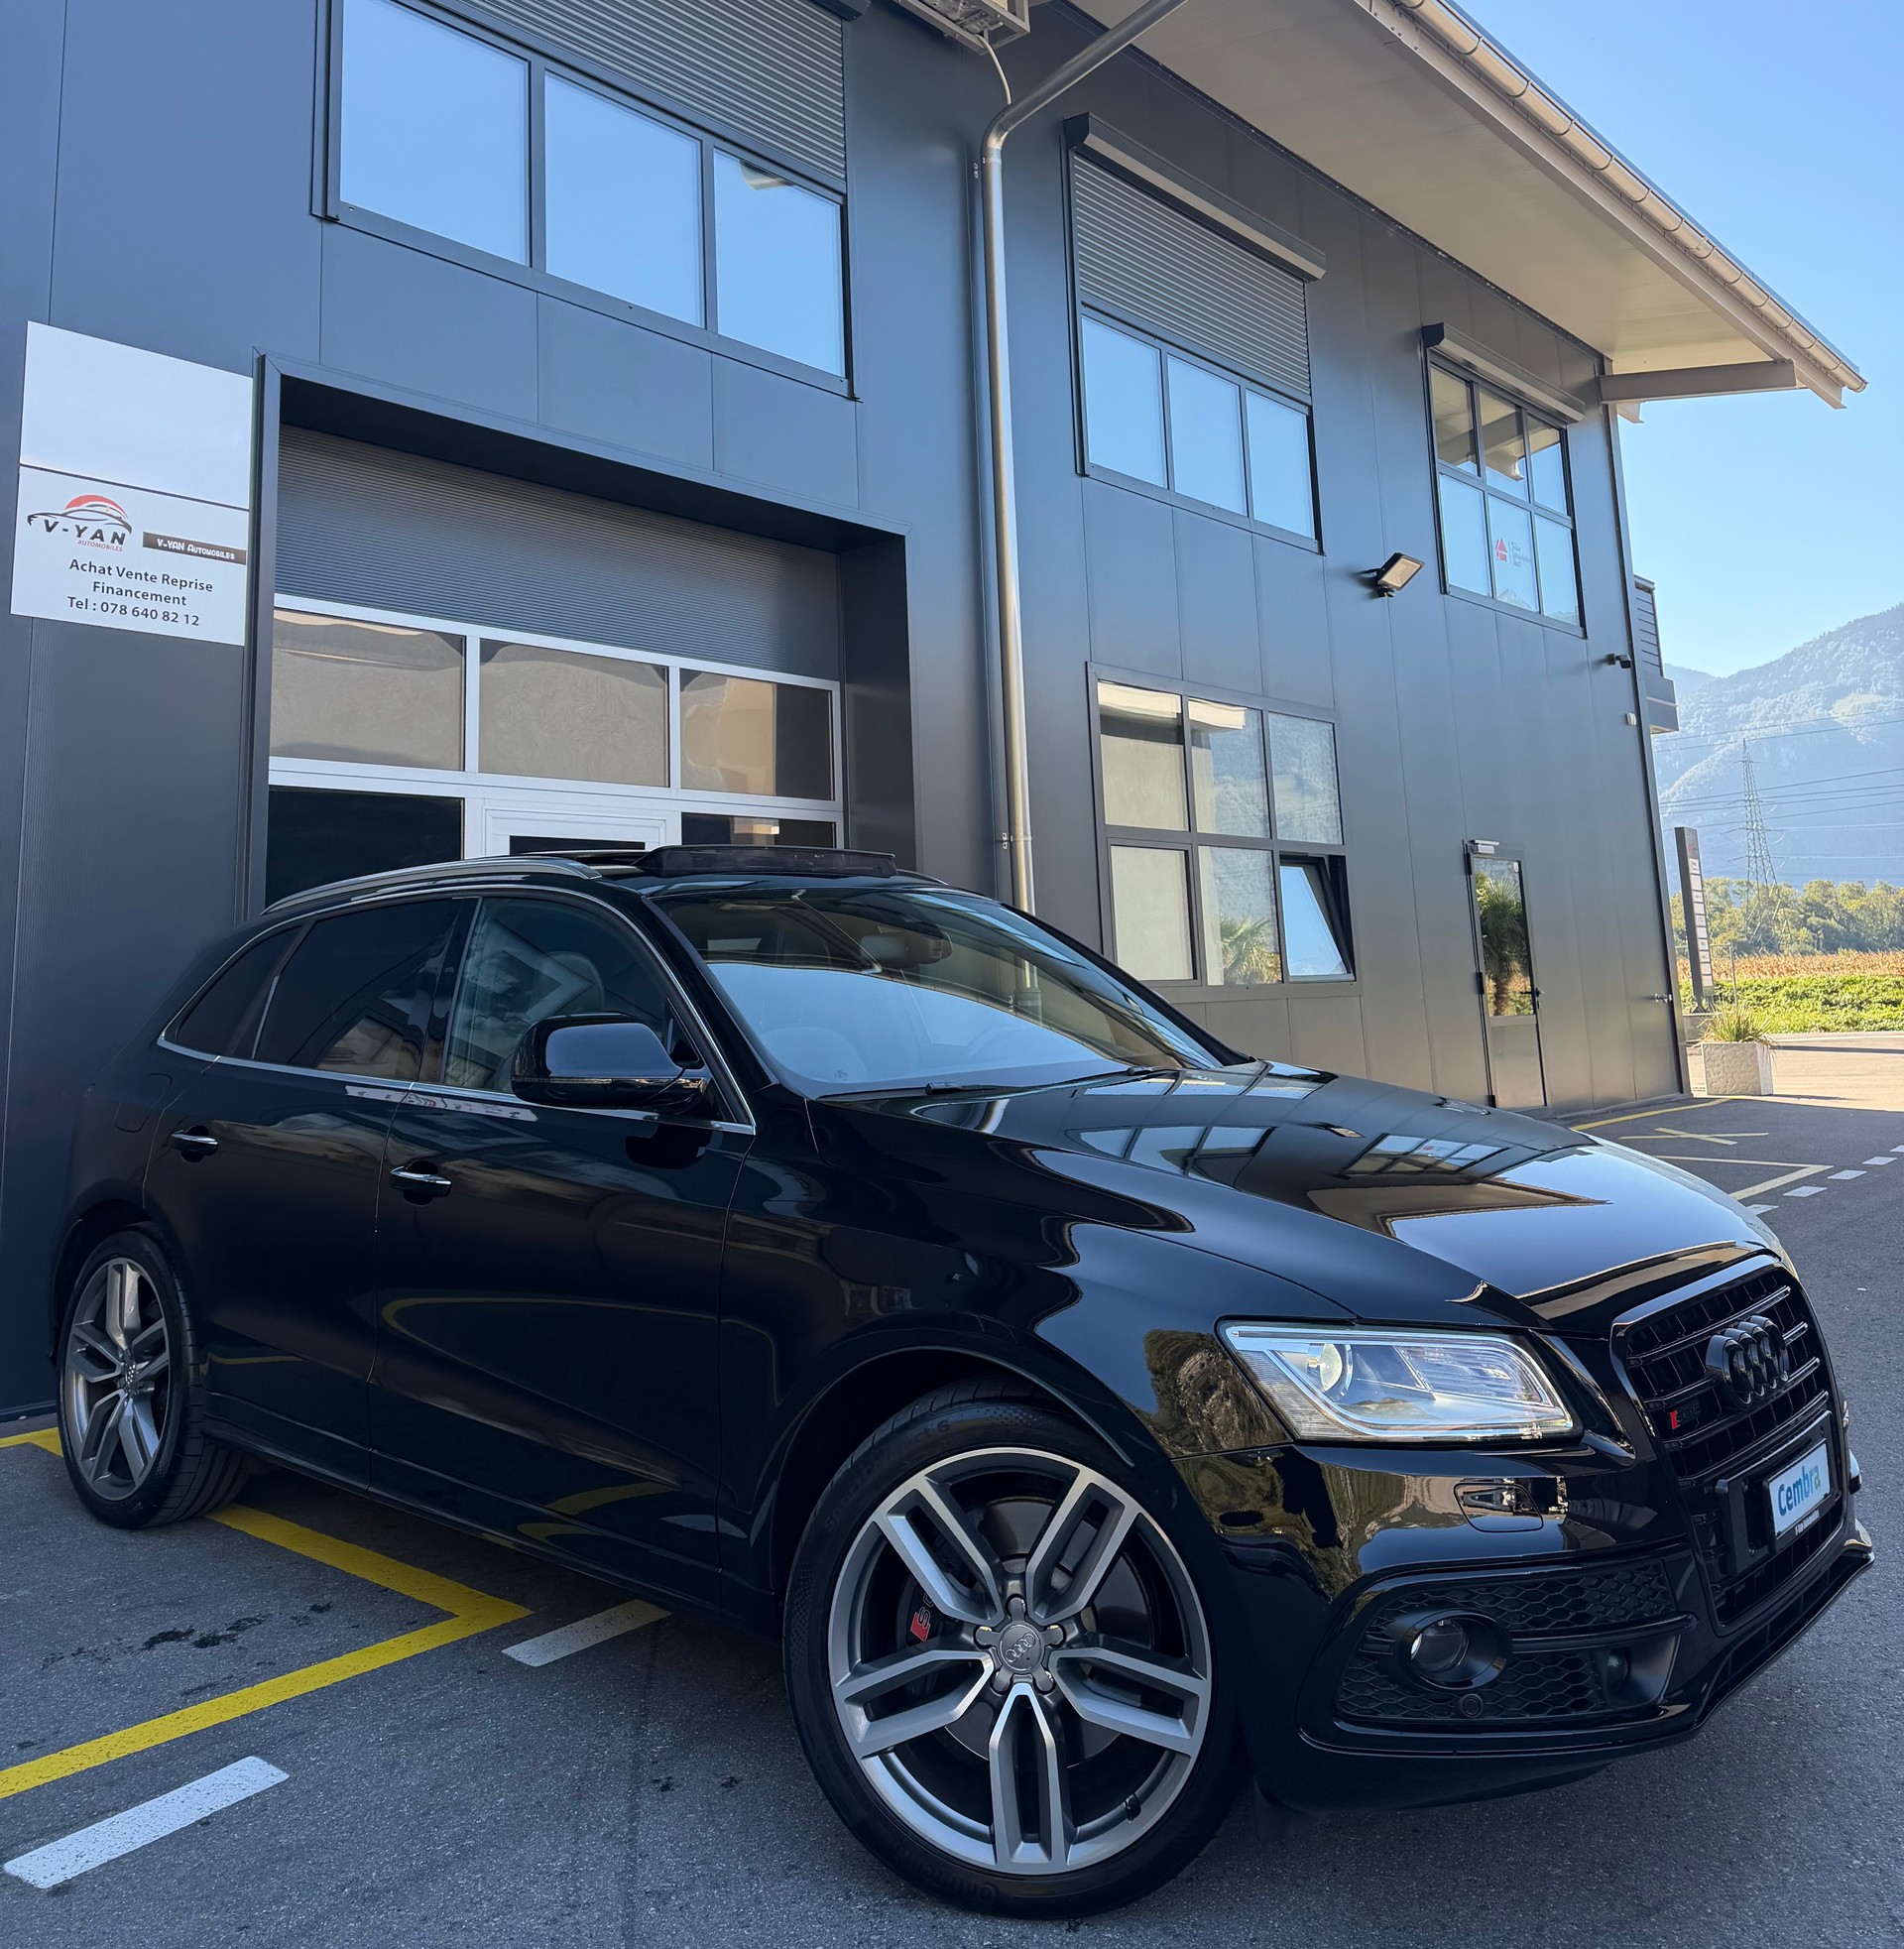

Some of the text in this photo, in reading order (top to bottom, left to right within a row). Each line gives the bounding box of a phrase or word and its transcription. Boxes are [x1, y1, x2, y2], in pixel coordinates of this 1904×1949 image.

[44, 519, 126, 546] V-YAN
[157, 538, 185, 551] V-YAN
[77, 539, 123, 552] AUTOMOBILES
[69, 558, 213, 592] Achat Vente Reprise
[92, 581, 186, 606] Financement
[100, 601, 128, 616] 078
[131, 606, 159, 620] 640
[162, 611, 178, 623] 82
[183, 614, 199, 626] 12
[1778, 1465, 1822, 1517] Cembra
